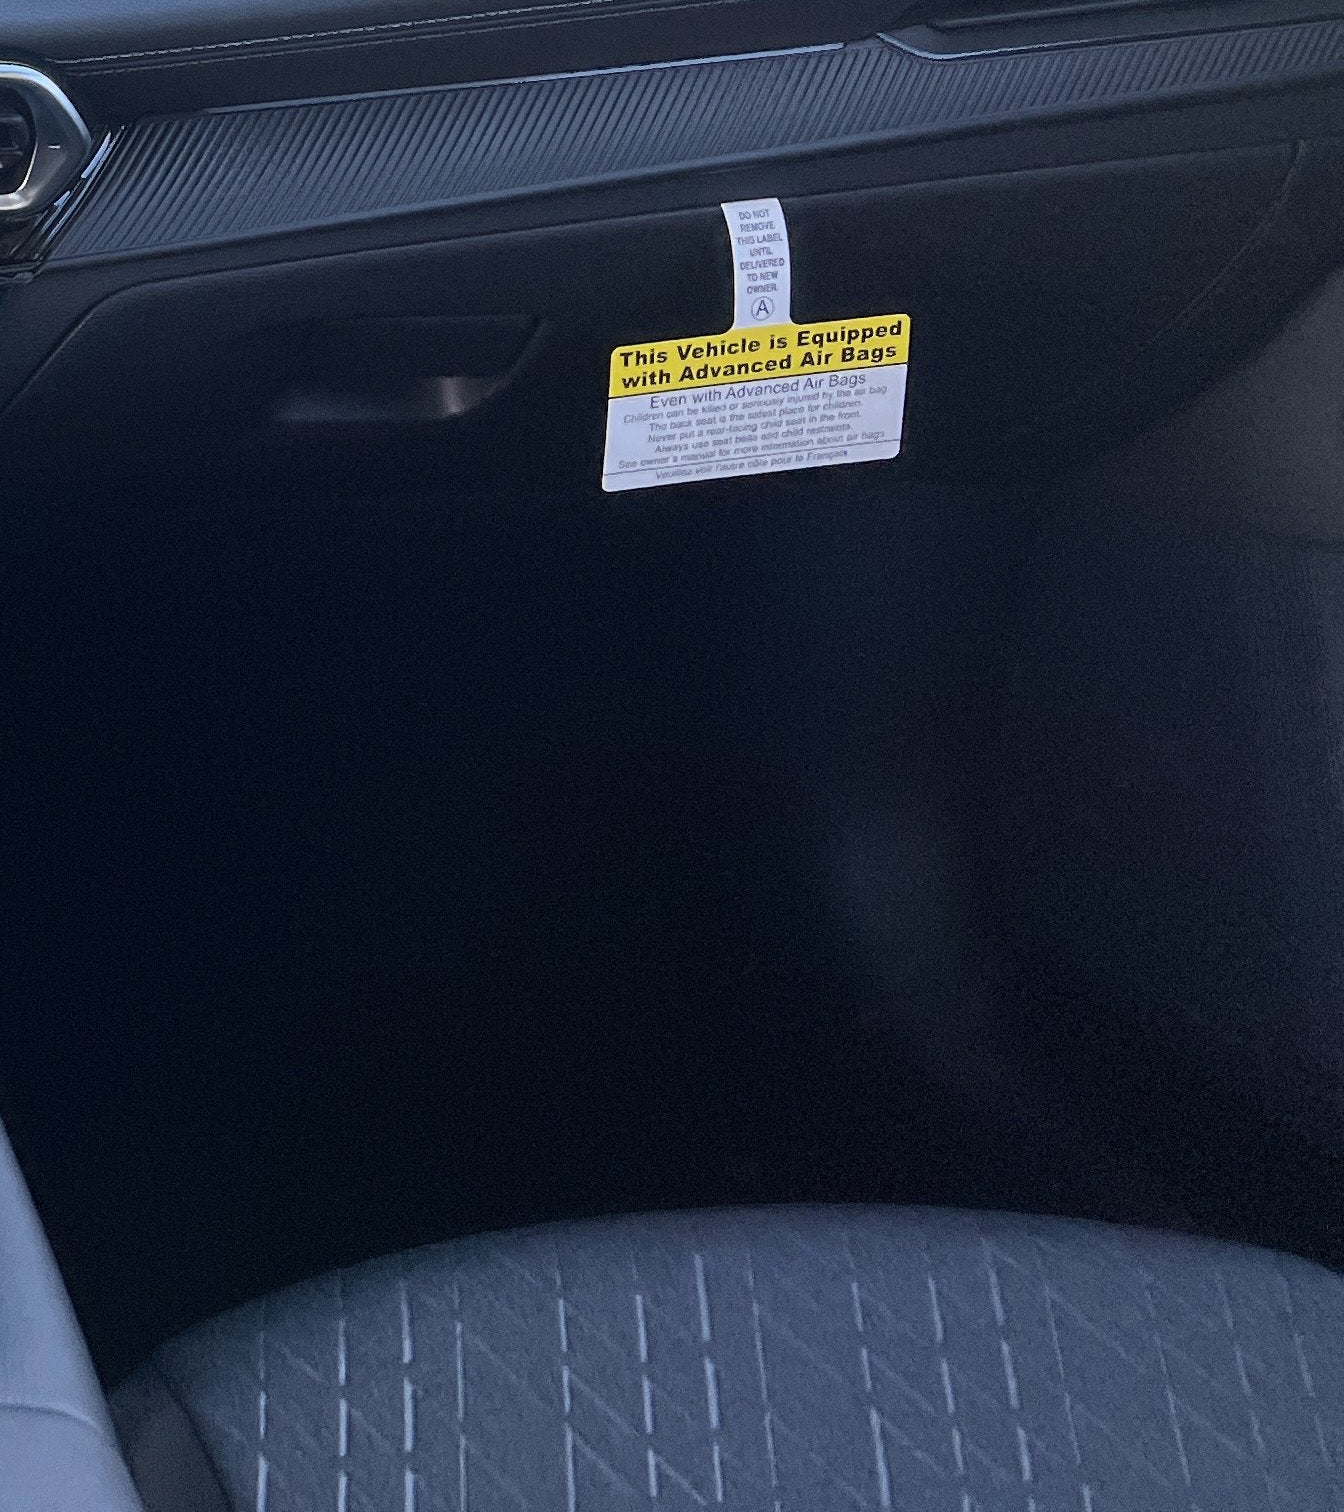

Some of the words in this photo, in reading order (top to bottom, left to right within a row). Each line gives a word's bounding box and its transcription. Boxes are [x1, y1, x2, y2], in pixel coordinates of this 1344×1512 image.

[738, 211, 751, 220] DO
[753, 209, 770, 218] NOT
[740, 221, 776, 232] REMOVE
[737, 236, 755, 246] THIS
[756, 233, 784, 243] LABEL
[750, 246, 773, 257] UNTIL
[740, 258, 785, 270] DELIVERED
[747, 273, 758, 282] TO
[760, 271, 778, 280] NEW
[756, 300, 770, 316] A
[619, 348, 668, 368] This
[676, 338, 761, 361] Vehicle
[769, 334, 788, 350] is
[797, 320, 902, 348] Equipped
[622, 369, 670, 388] with
[678, 354, 792, 382] Advanced
[800, 350, 834, 368] Air
[841, 346, 897, 363] Bags
[650, 395, 687, 409] Even
[692, 389, 722, 404] with
[725, 379, 800, 400] Advanced
[803, 377, 825, 390] Air
[828, 374, 866, 388] Bags
